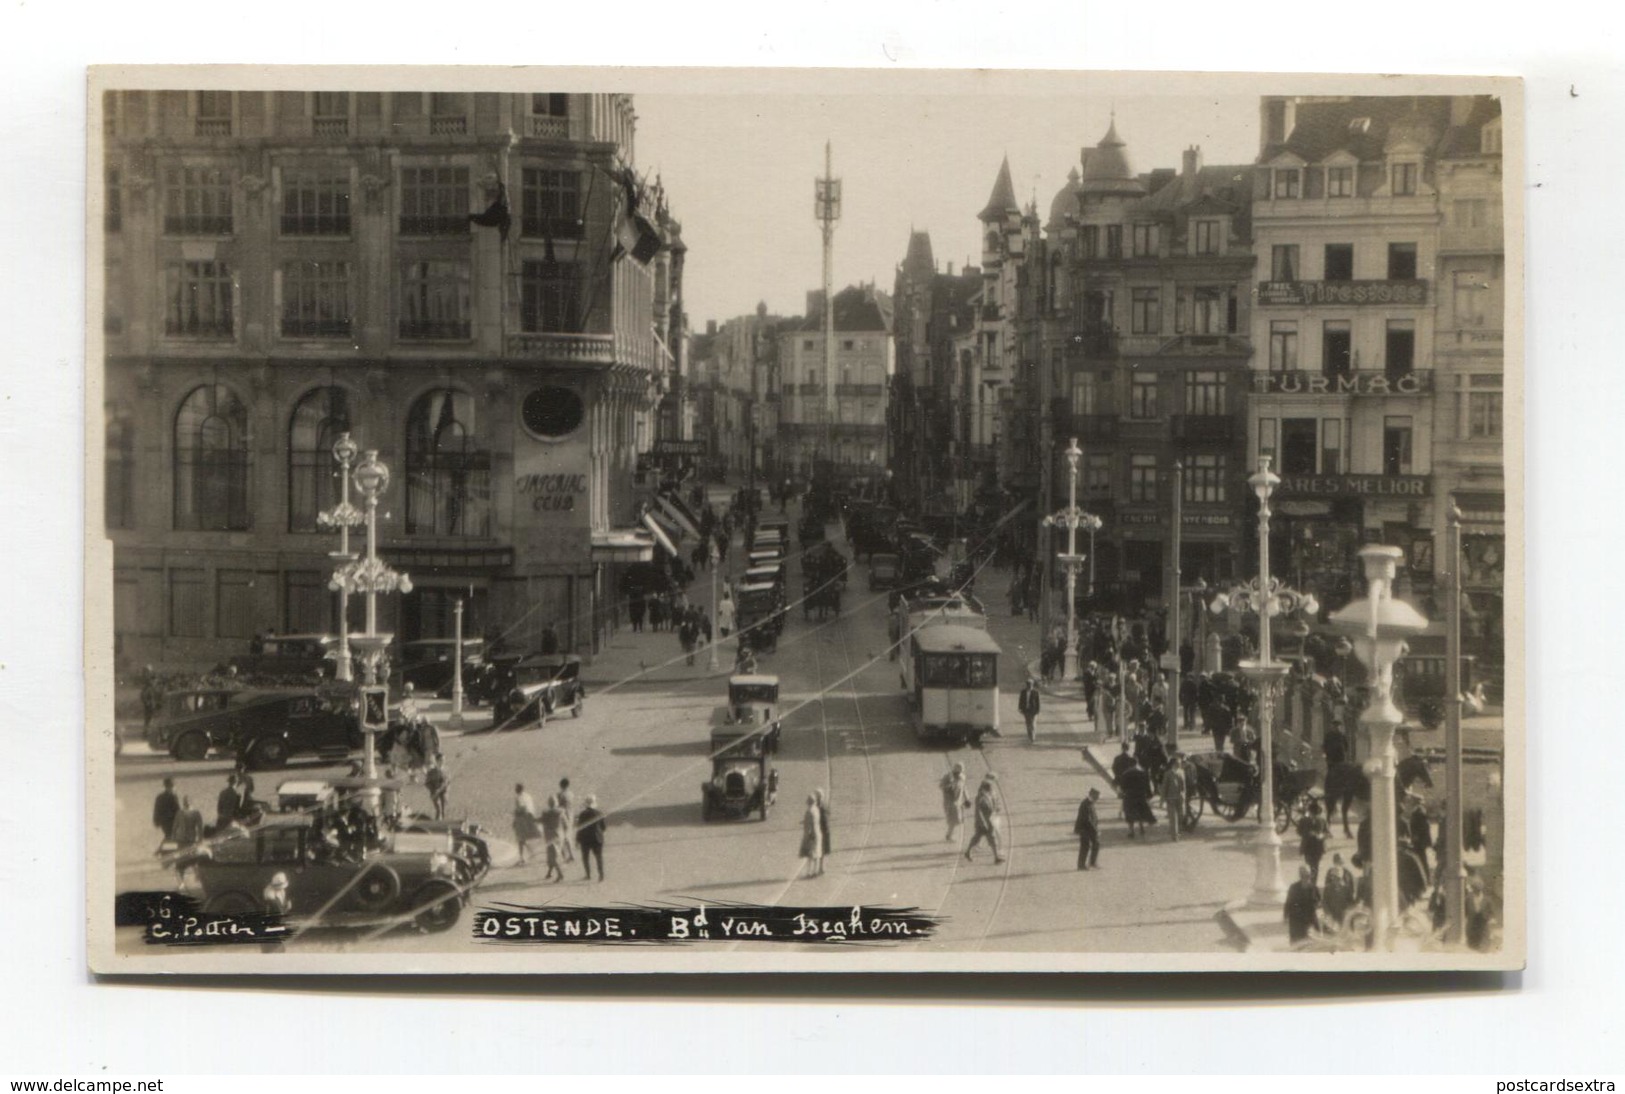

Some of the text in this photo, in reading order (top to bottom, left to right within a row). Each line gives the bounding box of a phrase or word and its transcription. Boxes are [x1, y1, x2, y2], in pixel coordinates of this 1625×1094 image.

[1300, 280, 1422, 304] Firestone
[1253, 373, 1421, 394] TURMAC
[1346, 478, 1425, 497] MELIOR
